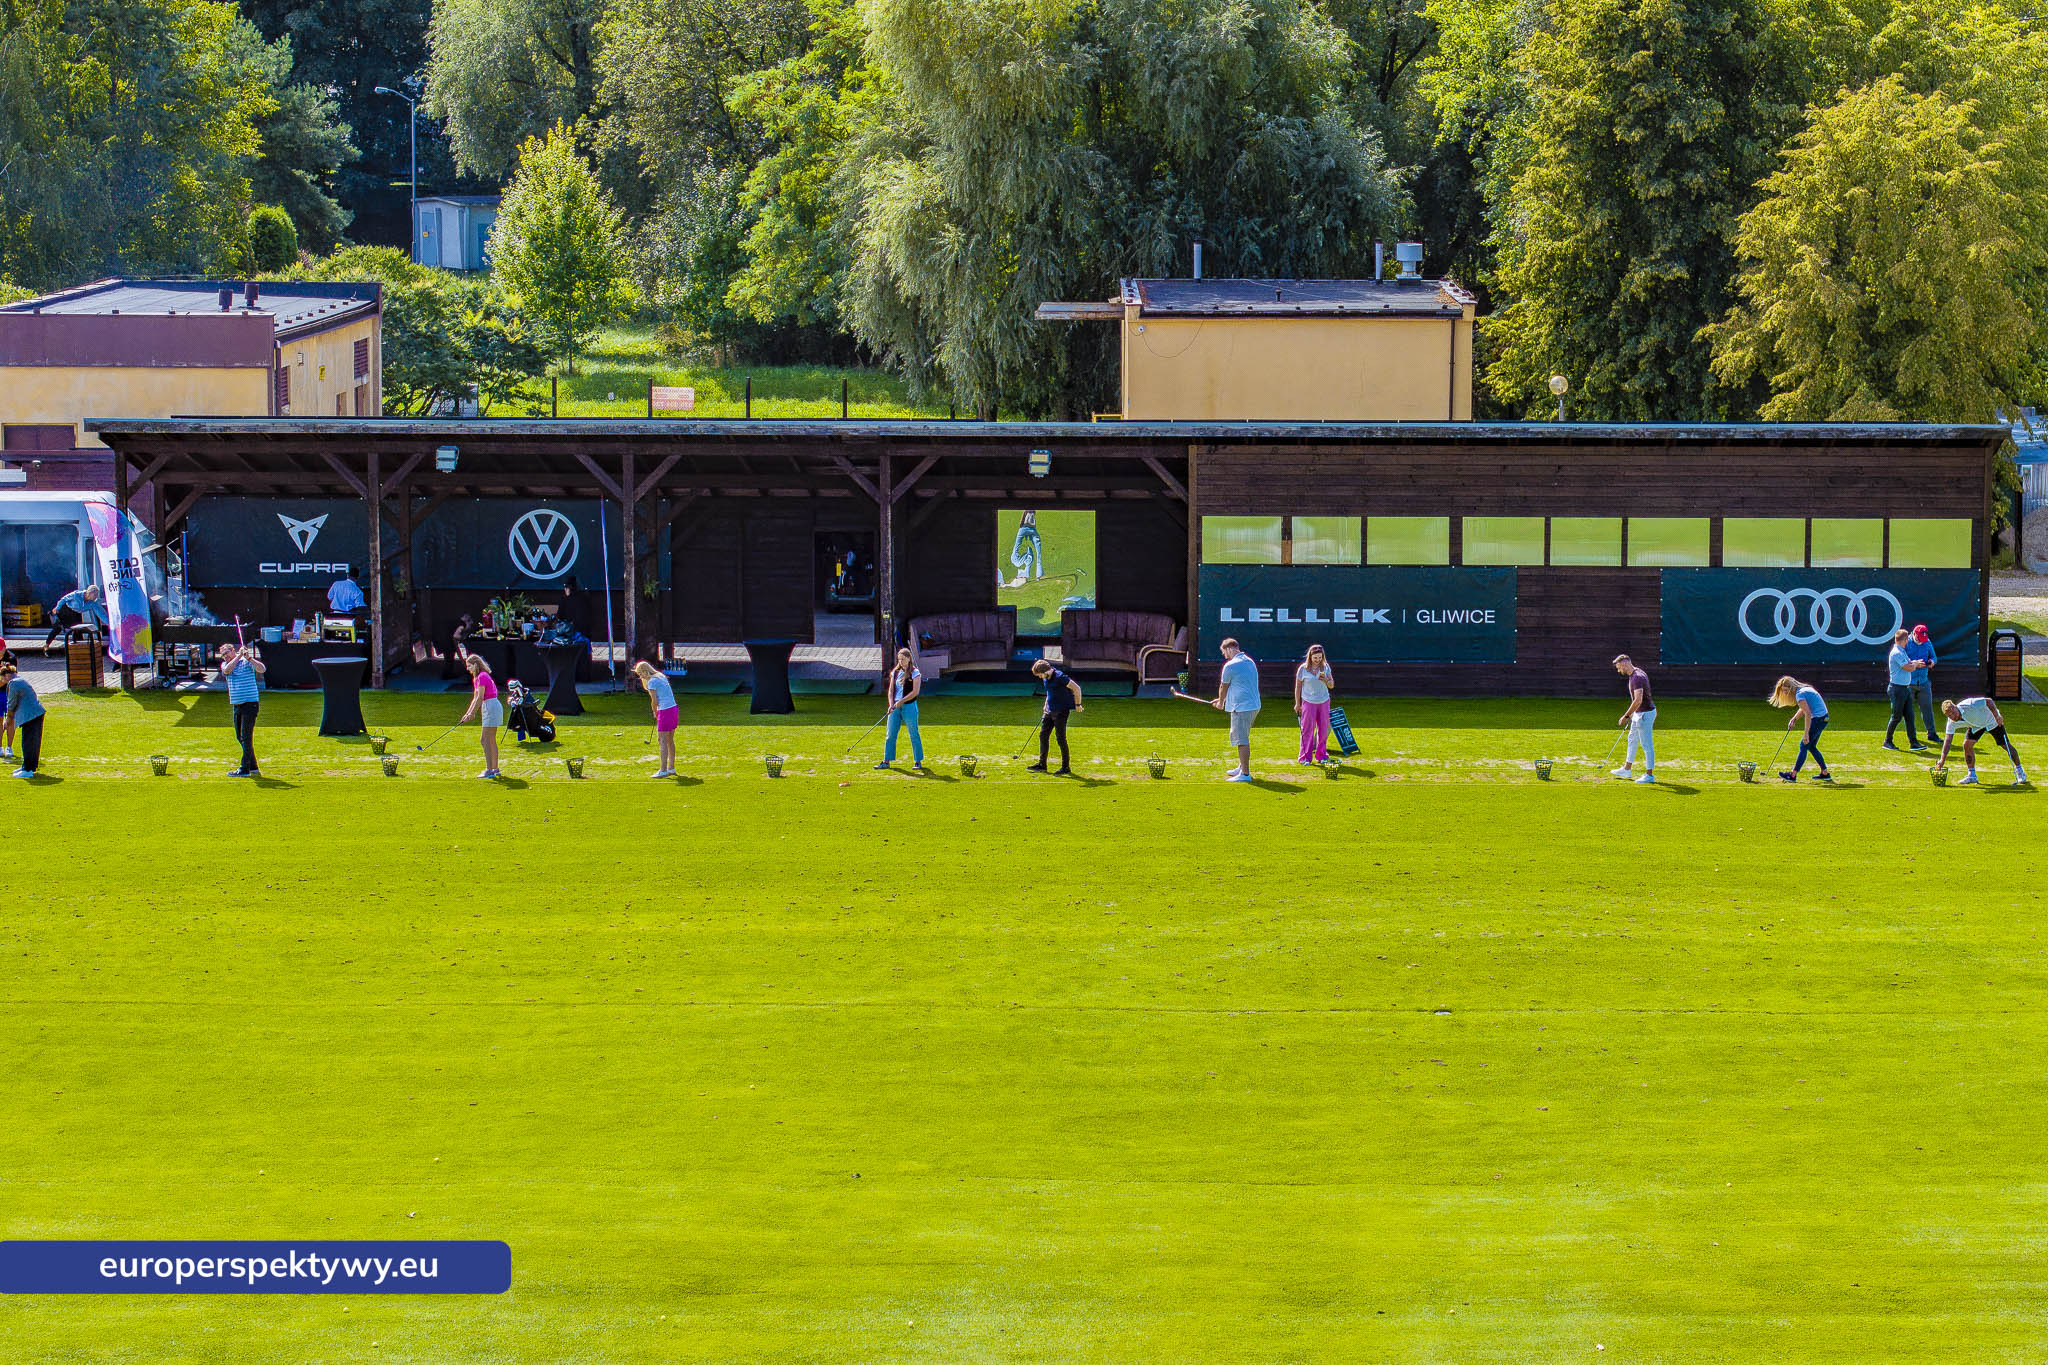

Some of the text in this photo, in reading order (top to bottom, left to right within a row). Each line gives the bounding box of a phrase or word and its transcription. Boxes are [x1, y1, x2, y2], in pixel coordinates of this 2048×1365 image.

[258, 562, 350, 574] CUPRA
[1220, 607, 1496, 624] LELLEK GLIWICE
